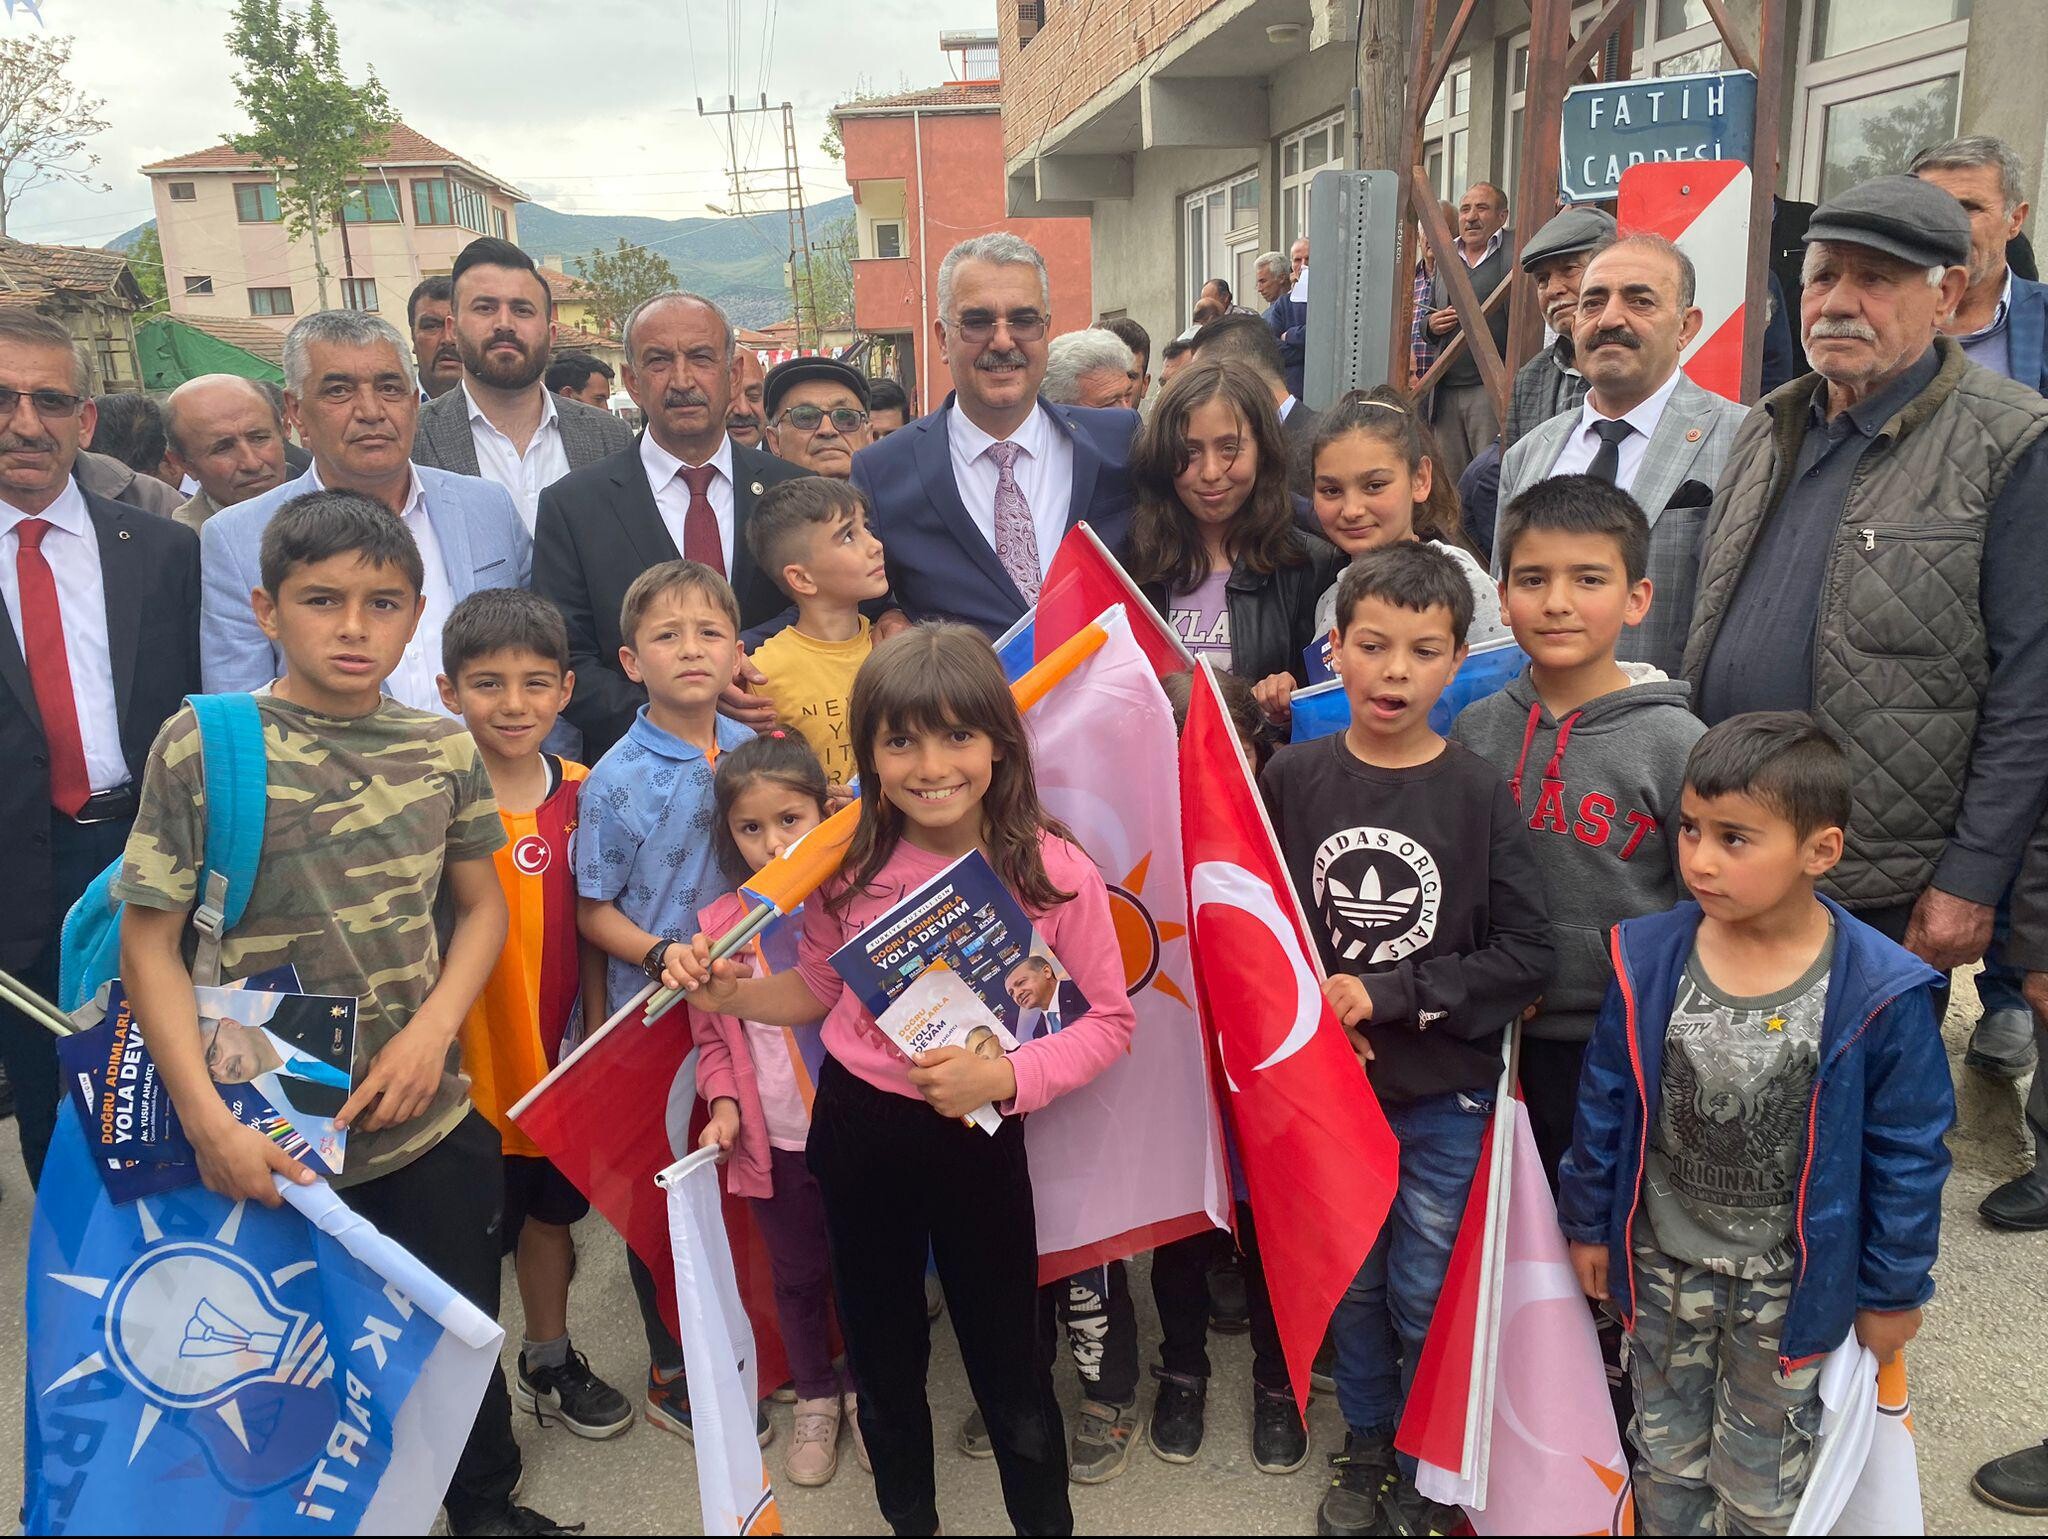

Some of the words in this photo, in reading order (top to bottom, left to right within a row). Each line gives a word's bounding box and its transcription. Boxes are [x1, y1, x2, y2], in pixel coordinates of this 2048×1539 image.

[1590, 85, 1724, 129] FATİH
[907, 894, 964, 939] ADIMLARLA
[1316, 831, 1388, 885] ADIDAS
[1389, 842, 1436, 957] ORIGINALS
[877, 939, 919, 971] YOLA
[918, 901, 971, 944] DEVAM
[904, 997, 950, 1042] ADIMLARLA
[909, 1023, 935, 1047] YOLA
[915, 1021, 947, 1054] DEVAM
[106, 1000, 132, 1087] ADIMLARLA
[101, 1093, 116, 1144] DOĞRU
[116, 1086, 136, 1144] YOLA
[141, 1100, 150, 1127] YUSUF
[1673, 1157, 1786, 1190] ORIGINALS
